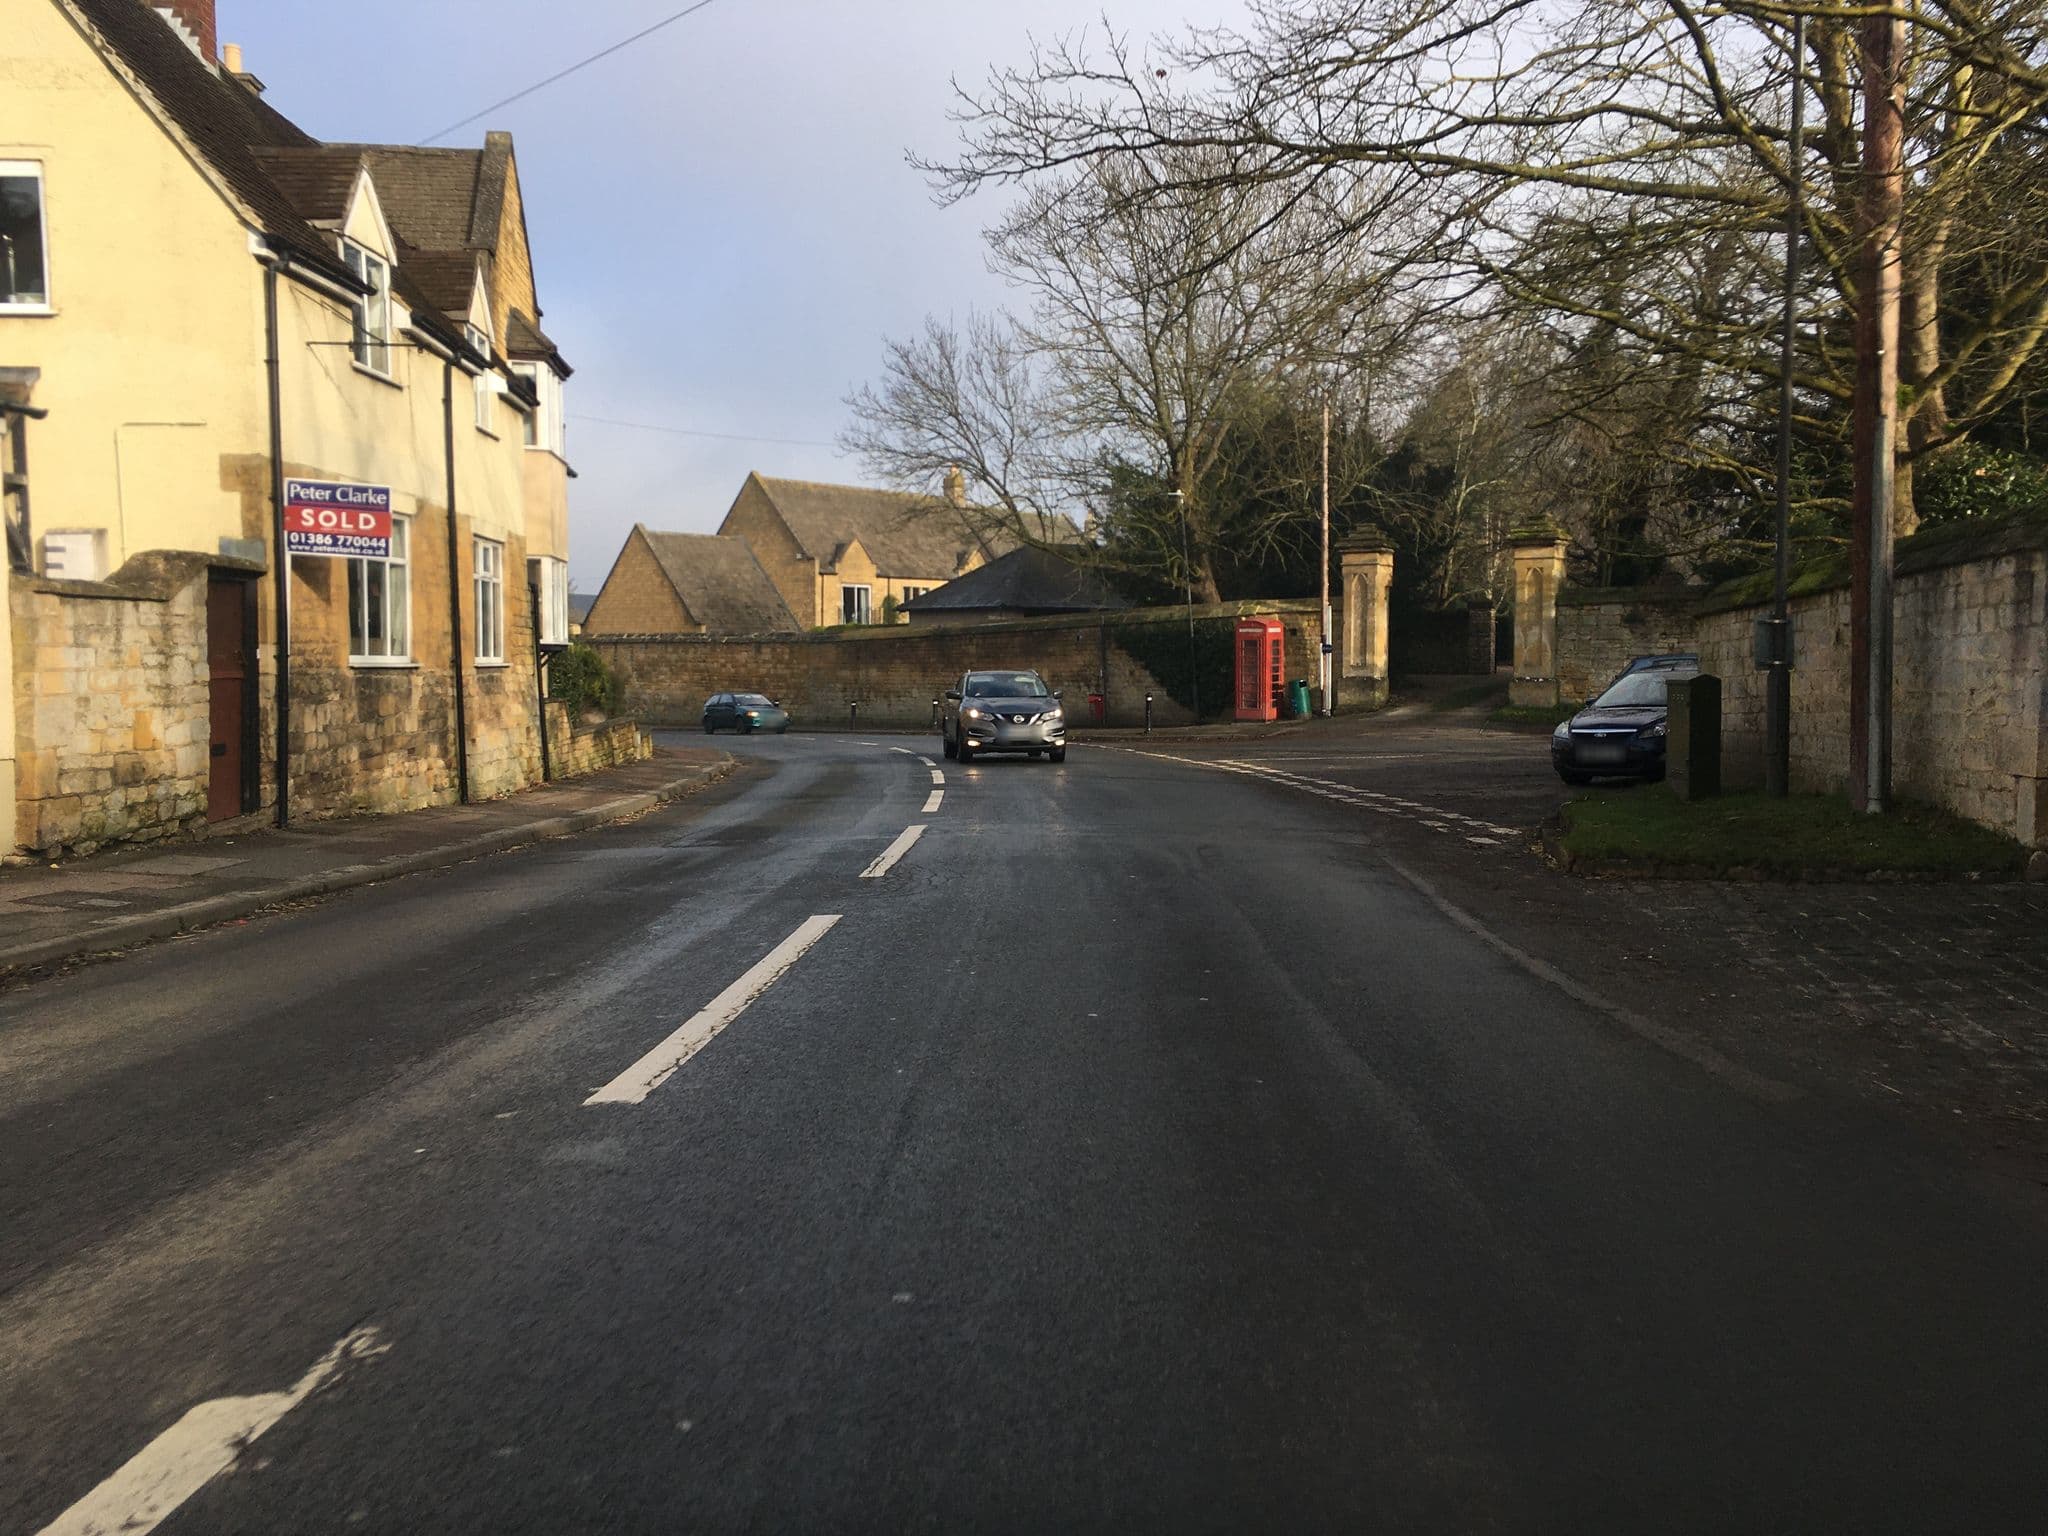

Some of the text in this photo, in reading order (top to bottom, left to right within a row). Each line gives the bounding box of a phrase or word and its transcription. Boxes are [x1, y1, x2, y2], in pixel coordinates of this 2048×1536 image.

[290, 483, 387, 505] Peter Clarke
[301, 508, 376, 530] SOLD
[290, 532, 386, 548] 01386 770044
